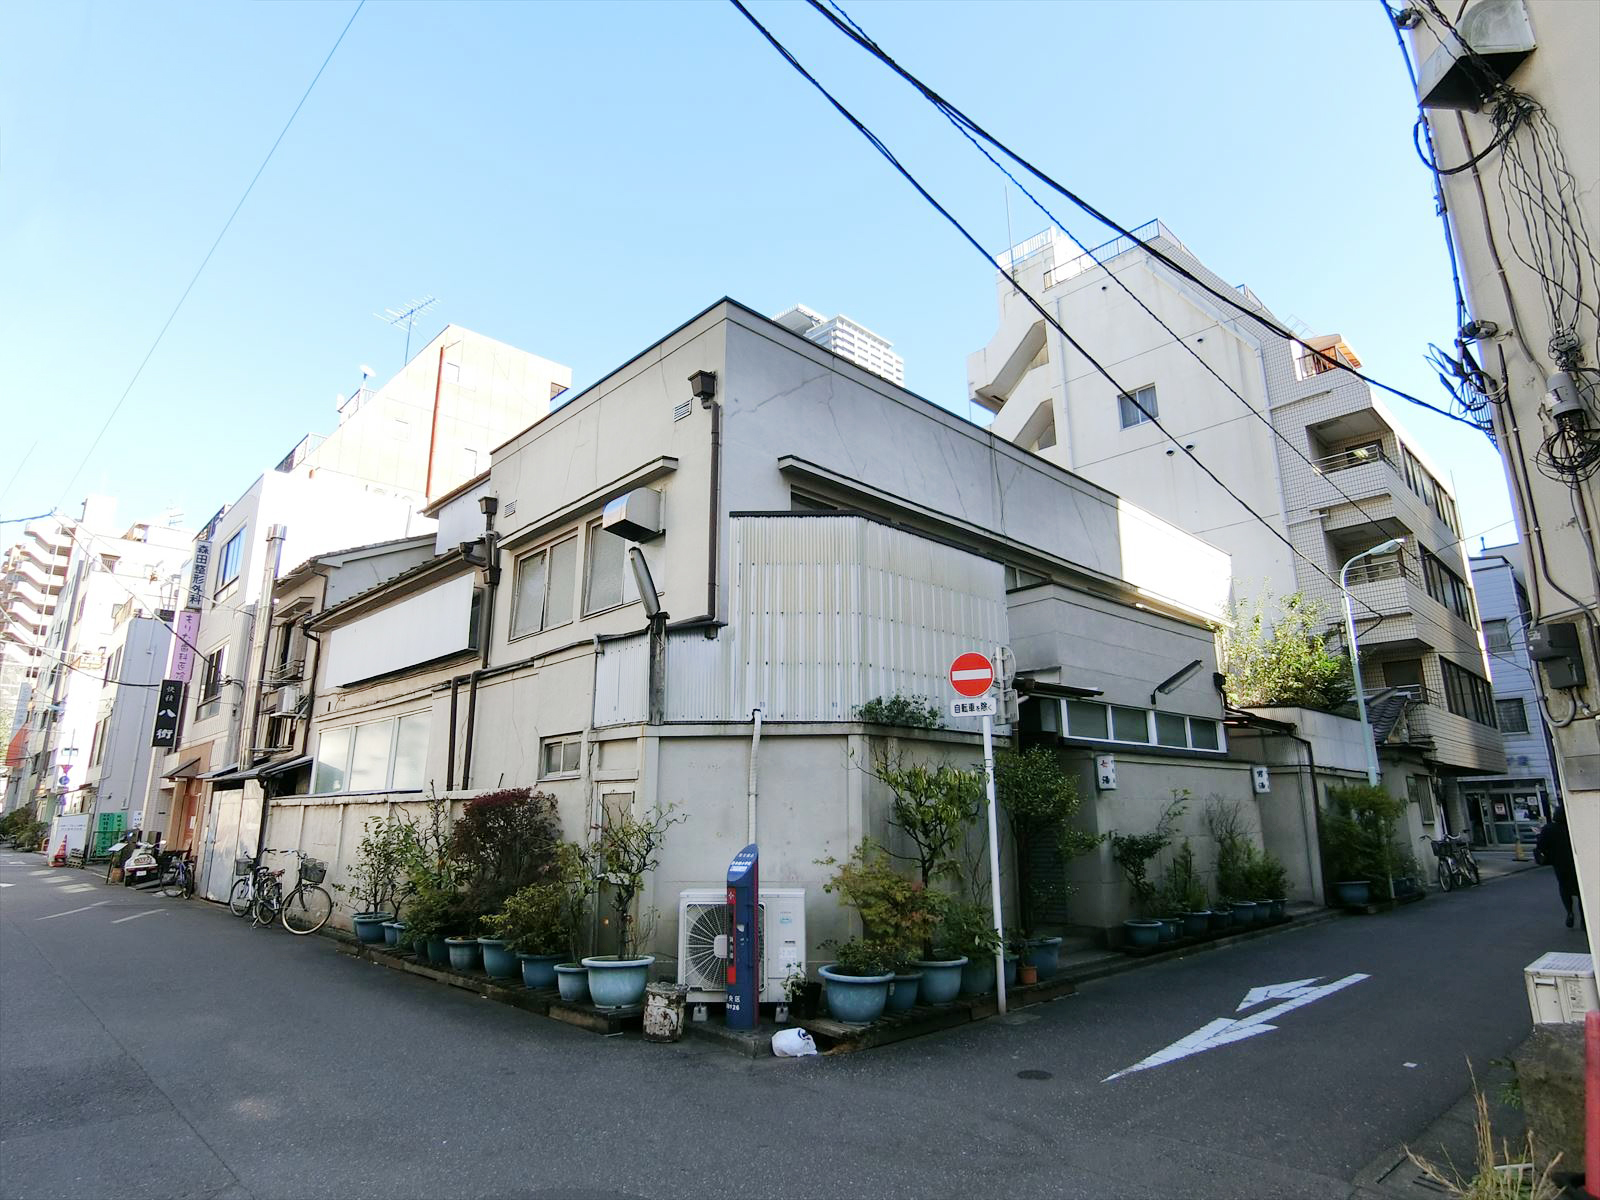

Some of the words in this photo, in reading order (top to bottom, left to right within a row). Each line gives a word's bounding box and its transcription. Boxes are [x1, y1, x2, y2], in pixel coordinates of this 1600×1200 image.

[189, 545, 209, 605] 森田整形外科
[954, 702, 992, 714] 自転車を除く
